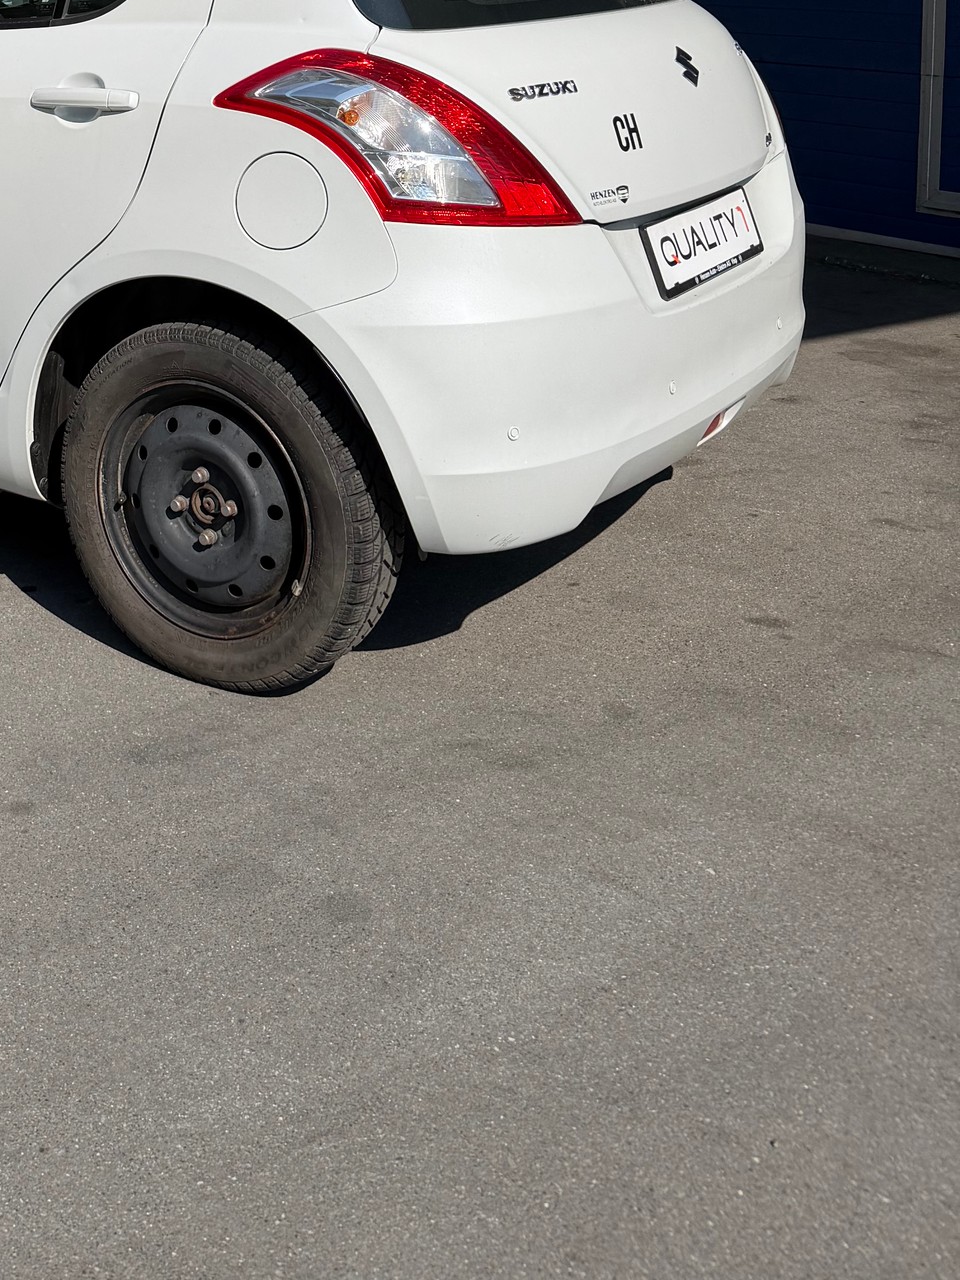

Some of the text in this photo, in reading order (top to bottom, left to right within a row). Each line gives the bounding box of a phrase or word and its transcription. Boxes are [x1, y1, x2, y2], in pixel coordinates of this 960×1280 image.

[508, 80, 578, 102] SUZUKI
[612, 112, 643, 152] CH
[590, 189, 616, 200] HENZEN
